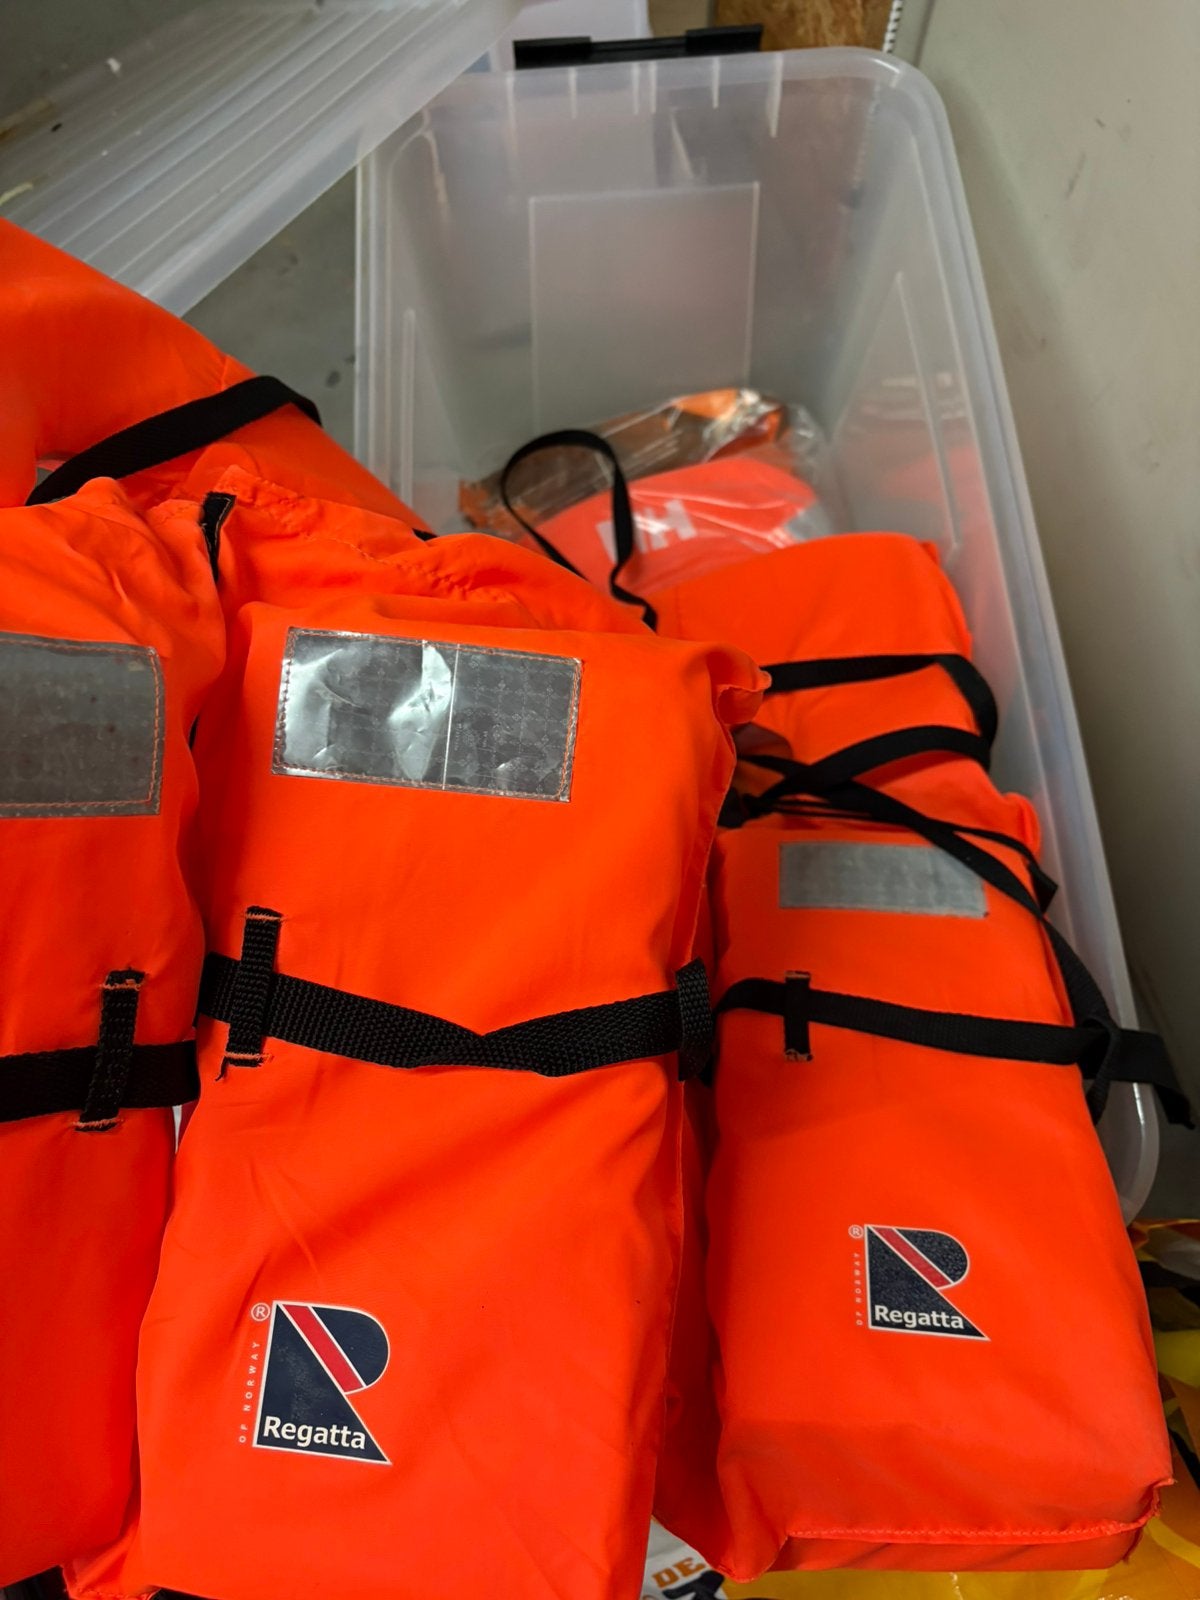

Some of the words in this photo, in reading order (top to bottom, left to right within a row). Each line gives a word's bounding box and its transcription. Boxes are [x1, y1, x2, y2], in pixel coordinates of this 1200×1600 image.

[874, 1305, 964, 1329] Regatta
[243, 1342, 260, 1412] NORWAY
[239, 1424, 249, 1443] OF
[263, 1416, 366, 1449] Regatta
